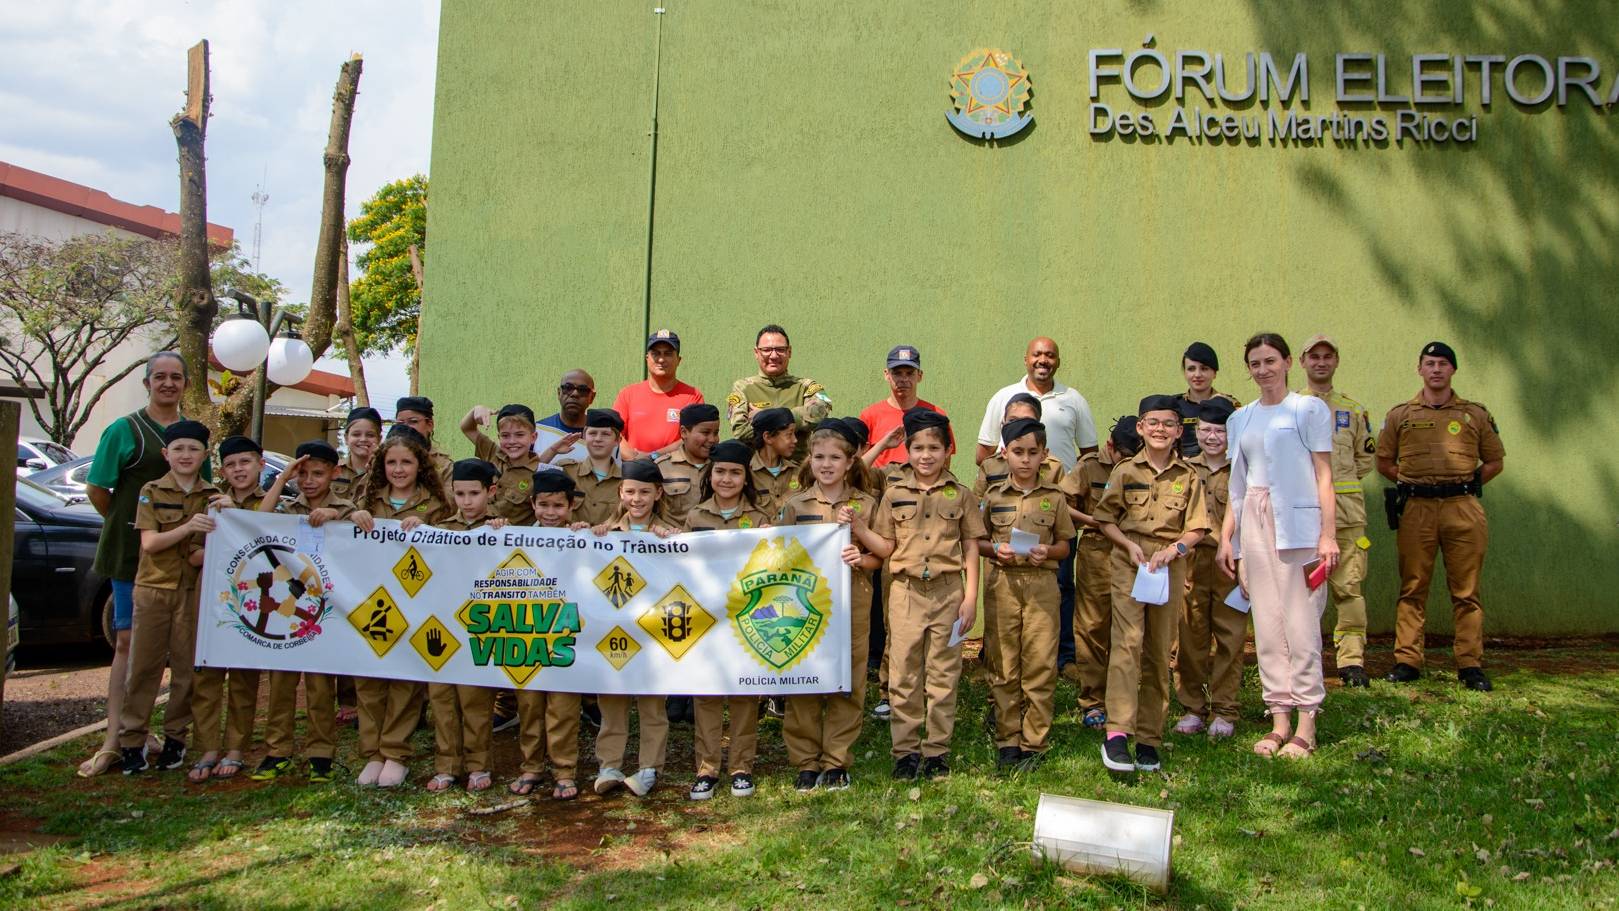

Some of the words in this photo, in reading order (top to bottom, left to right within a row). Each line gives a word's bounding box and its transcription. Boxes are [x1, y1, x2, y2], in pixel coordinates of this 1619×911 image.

[1088, 33, 1309, 101] FÓRUM
[1089, 103, 1158, 136] Des.
[1166, 106, 1260, 138] Alceu
[1268, 107, 1388, 141] Martins
[1396, 109, 1477, 142] Ricci
[411, 531, 471, 545] Didático
[477, 533, 497, 546] de
[503, 533, 587, 551] Educação
[593, 541, 613, 551] no
[620, 540, 689, 554] Trânsito
[227, 536, 265, 575] CONSELHO
[281, 536, 330, 583] COIDADE
[474, 577, 557, 588] RESPONSABILIDADE
[495, 568, 515, 577] AGIR
[517, 568, 537, 577] COM
[470, 592, 480, 600] NO
[528, 590, 566, 599] TAMBÉM
[467, 603, 581, 634] SALVA
[239, 627, 271, 649] COMARCA
[273, 642, 283, 650] DE
[609, 637, 628, 651] 60
[784, 618, 818, 658] MILITAR
[469, 636, 576, 667] VIDAS
[739, 675, 777, 686] POLÍCIA
[779, 676, 819, 685] MILITAR
